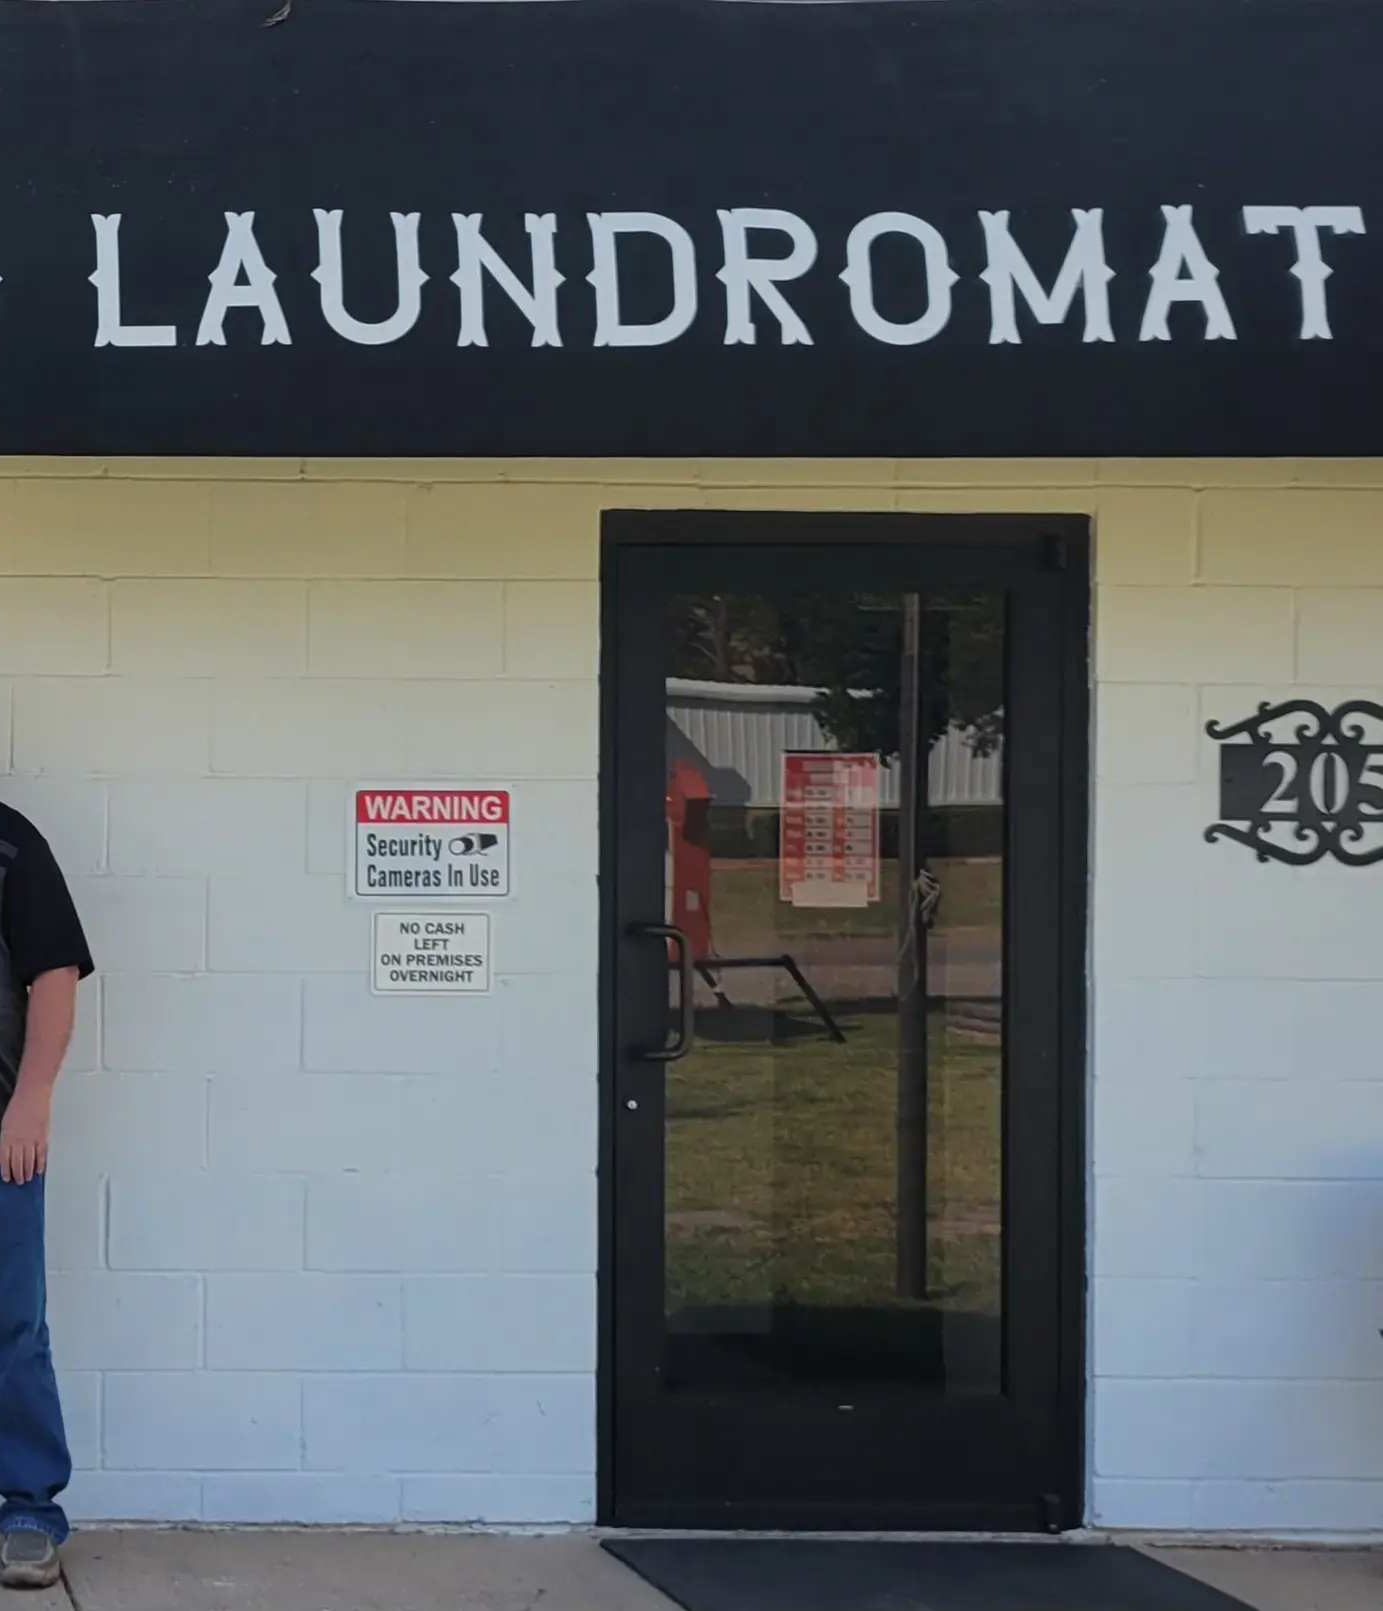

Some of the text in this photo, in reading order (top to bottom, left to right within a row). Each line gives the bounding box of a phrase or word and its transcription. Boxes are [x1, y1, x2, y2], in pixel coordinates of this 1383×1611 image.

[87, 204, 1366, 348] LAUNDROMAT
[1259, 750, 1383, 816] 205
[364, 795, 503, 820] WARNING
[366, 832, 443, 861] Security
[366, 863, 500, 888] Cameras In Use
[399, 922, 465, 935] NO CASH
[414, 938, 450, 951] LEFT
[380, 954, 483, 966] ON PREMISES
[389, 970, 474, 983] OVERNIGHT
